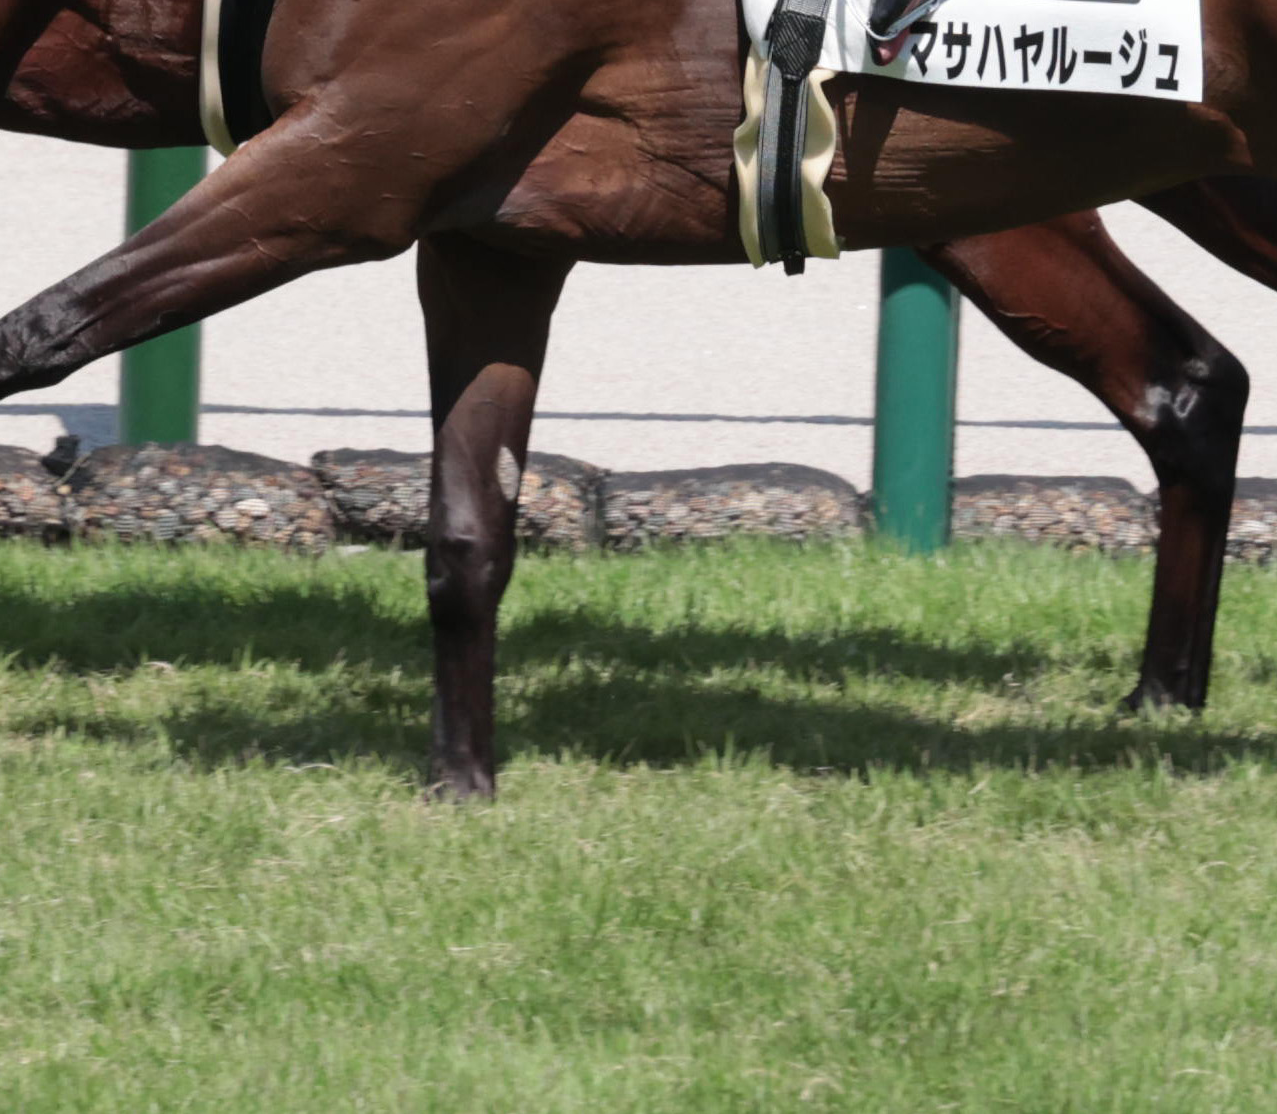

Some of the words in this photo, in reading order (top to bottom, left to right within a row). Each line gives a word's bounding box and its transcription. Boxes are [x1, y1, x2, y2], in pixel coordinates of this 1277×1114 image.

[909, 20, 1180, 92] マサハヤルージュ
